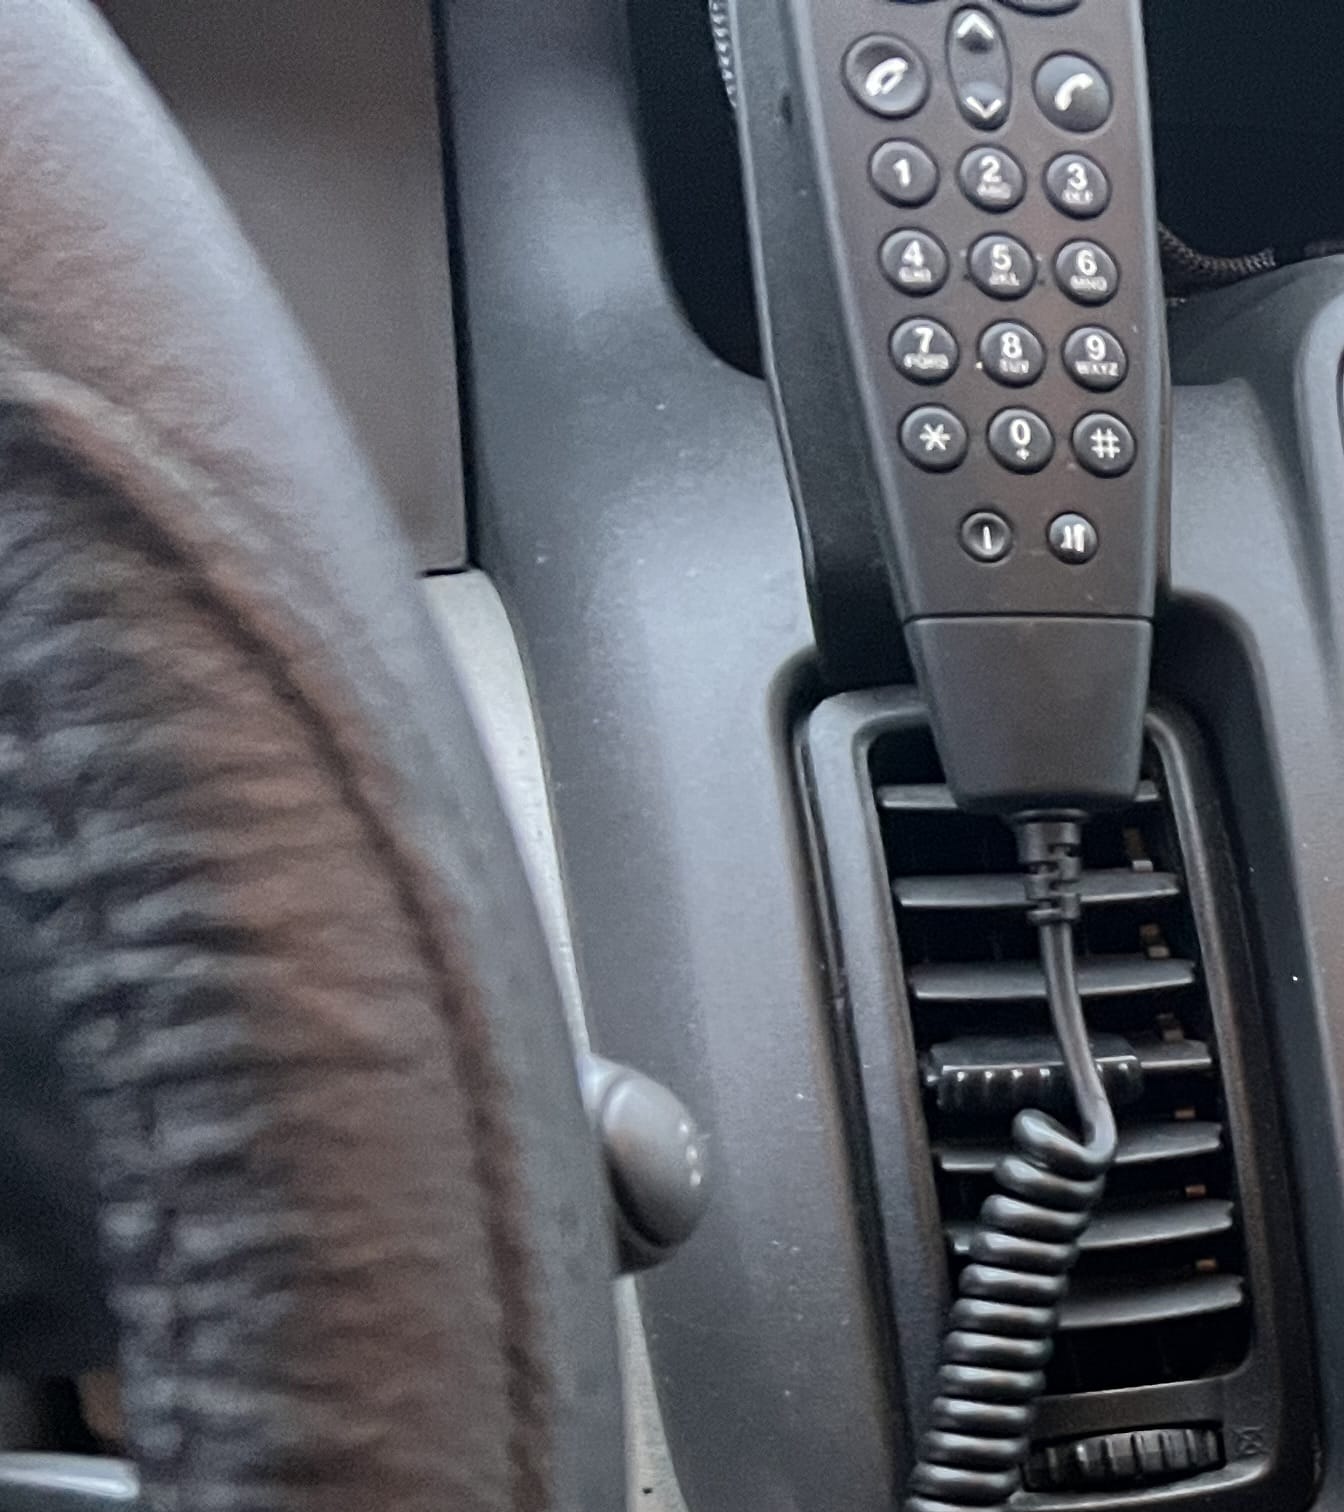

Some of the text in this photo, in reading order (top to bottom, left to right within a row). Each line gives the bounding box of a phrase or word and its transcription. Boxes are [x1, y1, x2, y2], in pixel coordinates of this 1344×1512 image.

[893, 158, 911, 187] 1
[980, 155, 1002, 183] 2
[1067, 162, 1088, 190] 3
[902, 240, 924, 267] 4
[991, 244, 1012, 271] 5
[1076, 249, 1098, 276] 6
[914, 327, 933, 353] 7
[1001, 332, 1023, 359] 8
[1085, 335, 1106, 360] 9
[1009, 418, 1031, 446] 0
